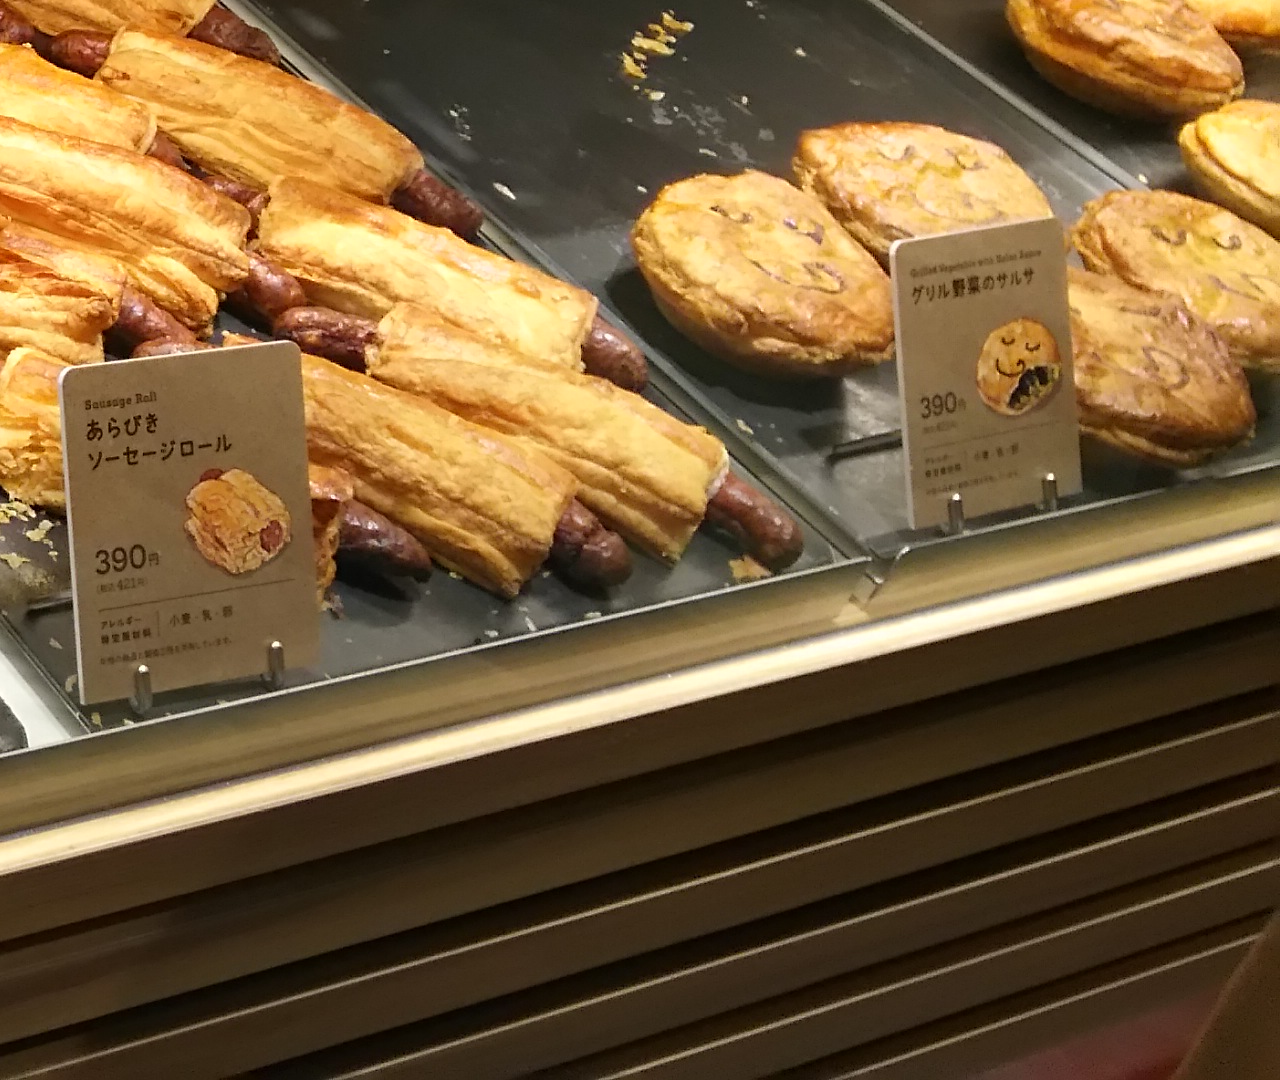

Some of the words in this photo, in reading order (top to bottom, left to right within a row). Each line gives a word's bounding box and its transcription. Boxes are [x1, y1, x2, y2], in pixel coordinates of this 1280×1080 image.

[912, 266, 1035, 305] グリル野菜のサルサ
[84, 395, 132, 411] Sausage
[86, 413, 159, 442] あらびき
[87, 435, 232, 470] ソーセージロール
[95, 544, 160, 575] 390円
